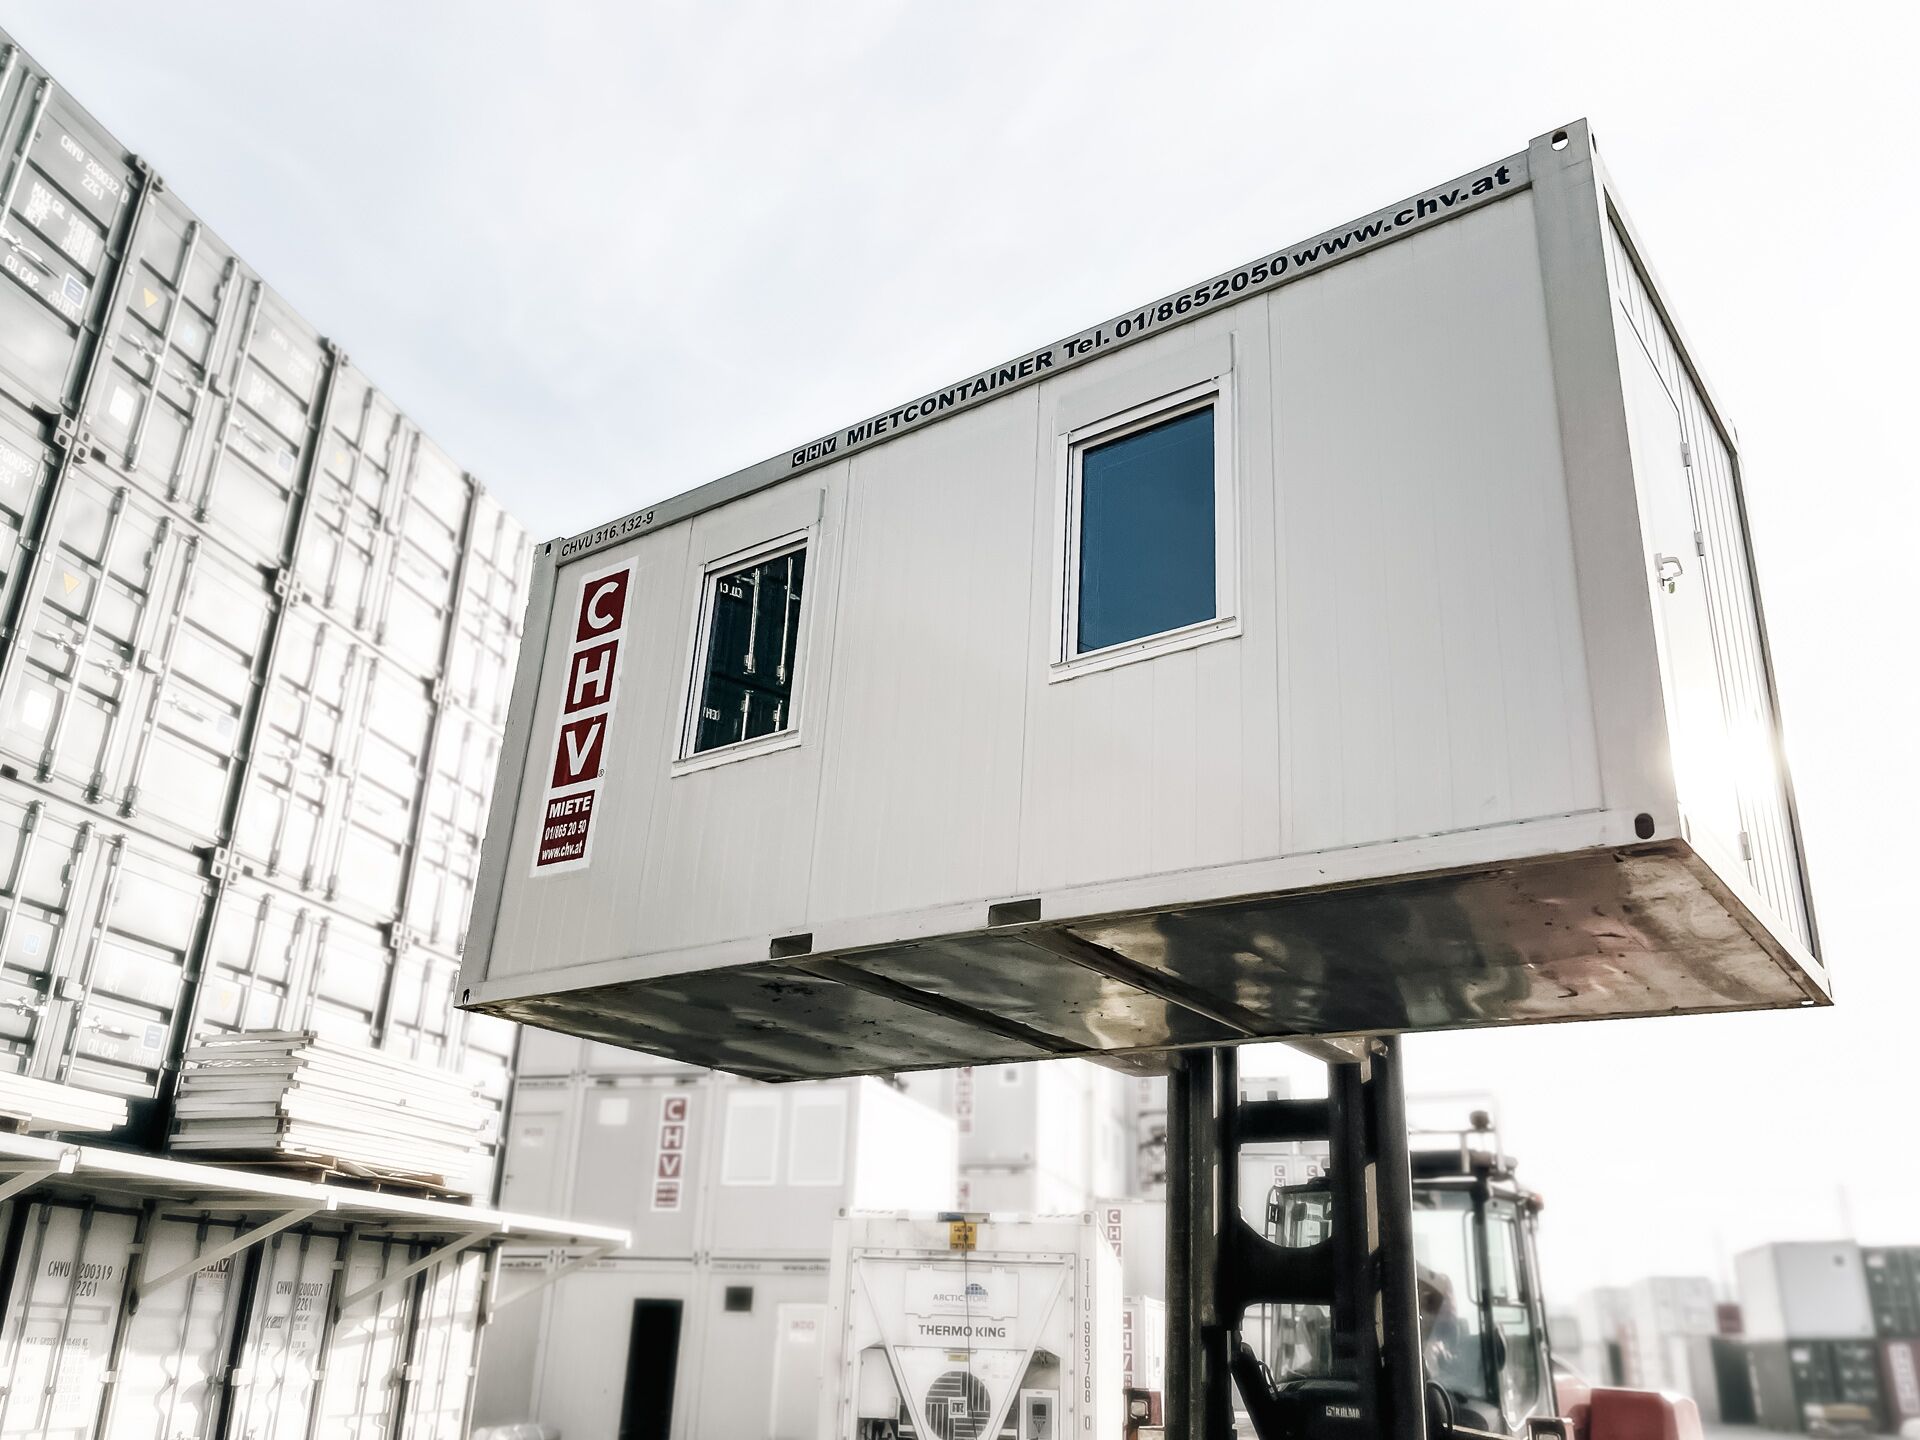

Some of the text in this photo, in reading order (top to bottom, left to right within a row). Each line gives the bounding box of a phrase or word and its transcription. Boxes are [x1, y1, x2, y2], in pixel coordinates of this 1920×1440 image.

[791, 165, 1511, 468] CHV MIETCONTAINER Tel. 01/8652050 www.chv.at
[561, 511, 655, 557] CHVU 316.132-9
[548, 795, 592, 819] MIETE
[567, 821, 577, 836] 20
[578, 819, 587, 835] 50
[541, 840, 583, 861] www.chv.at
[47, 1260, 71, 1278] CHVU
[79, 1263, 113, 1281] 200319
[197, 1272, 228, 1280] ONTAINER
[276, 1281, 293, 1296] CHVU
[299, 1282, 323, 1297] 200207
[918, 1324, 1006, 1338] THERMO KING
